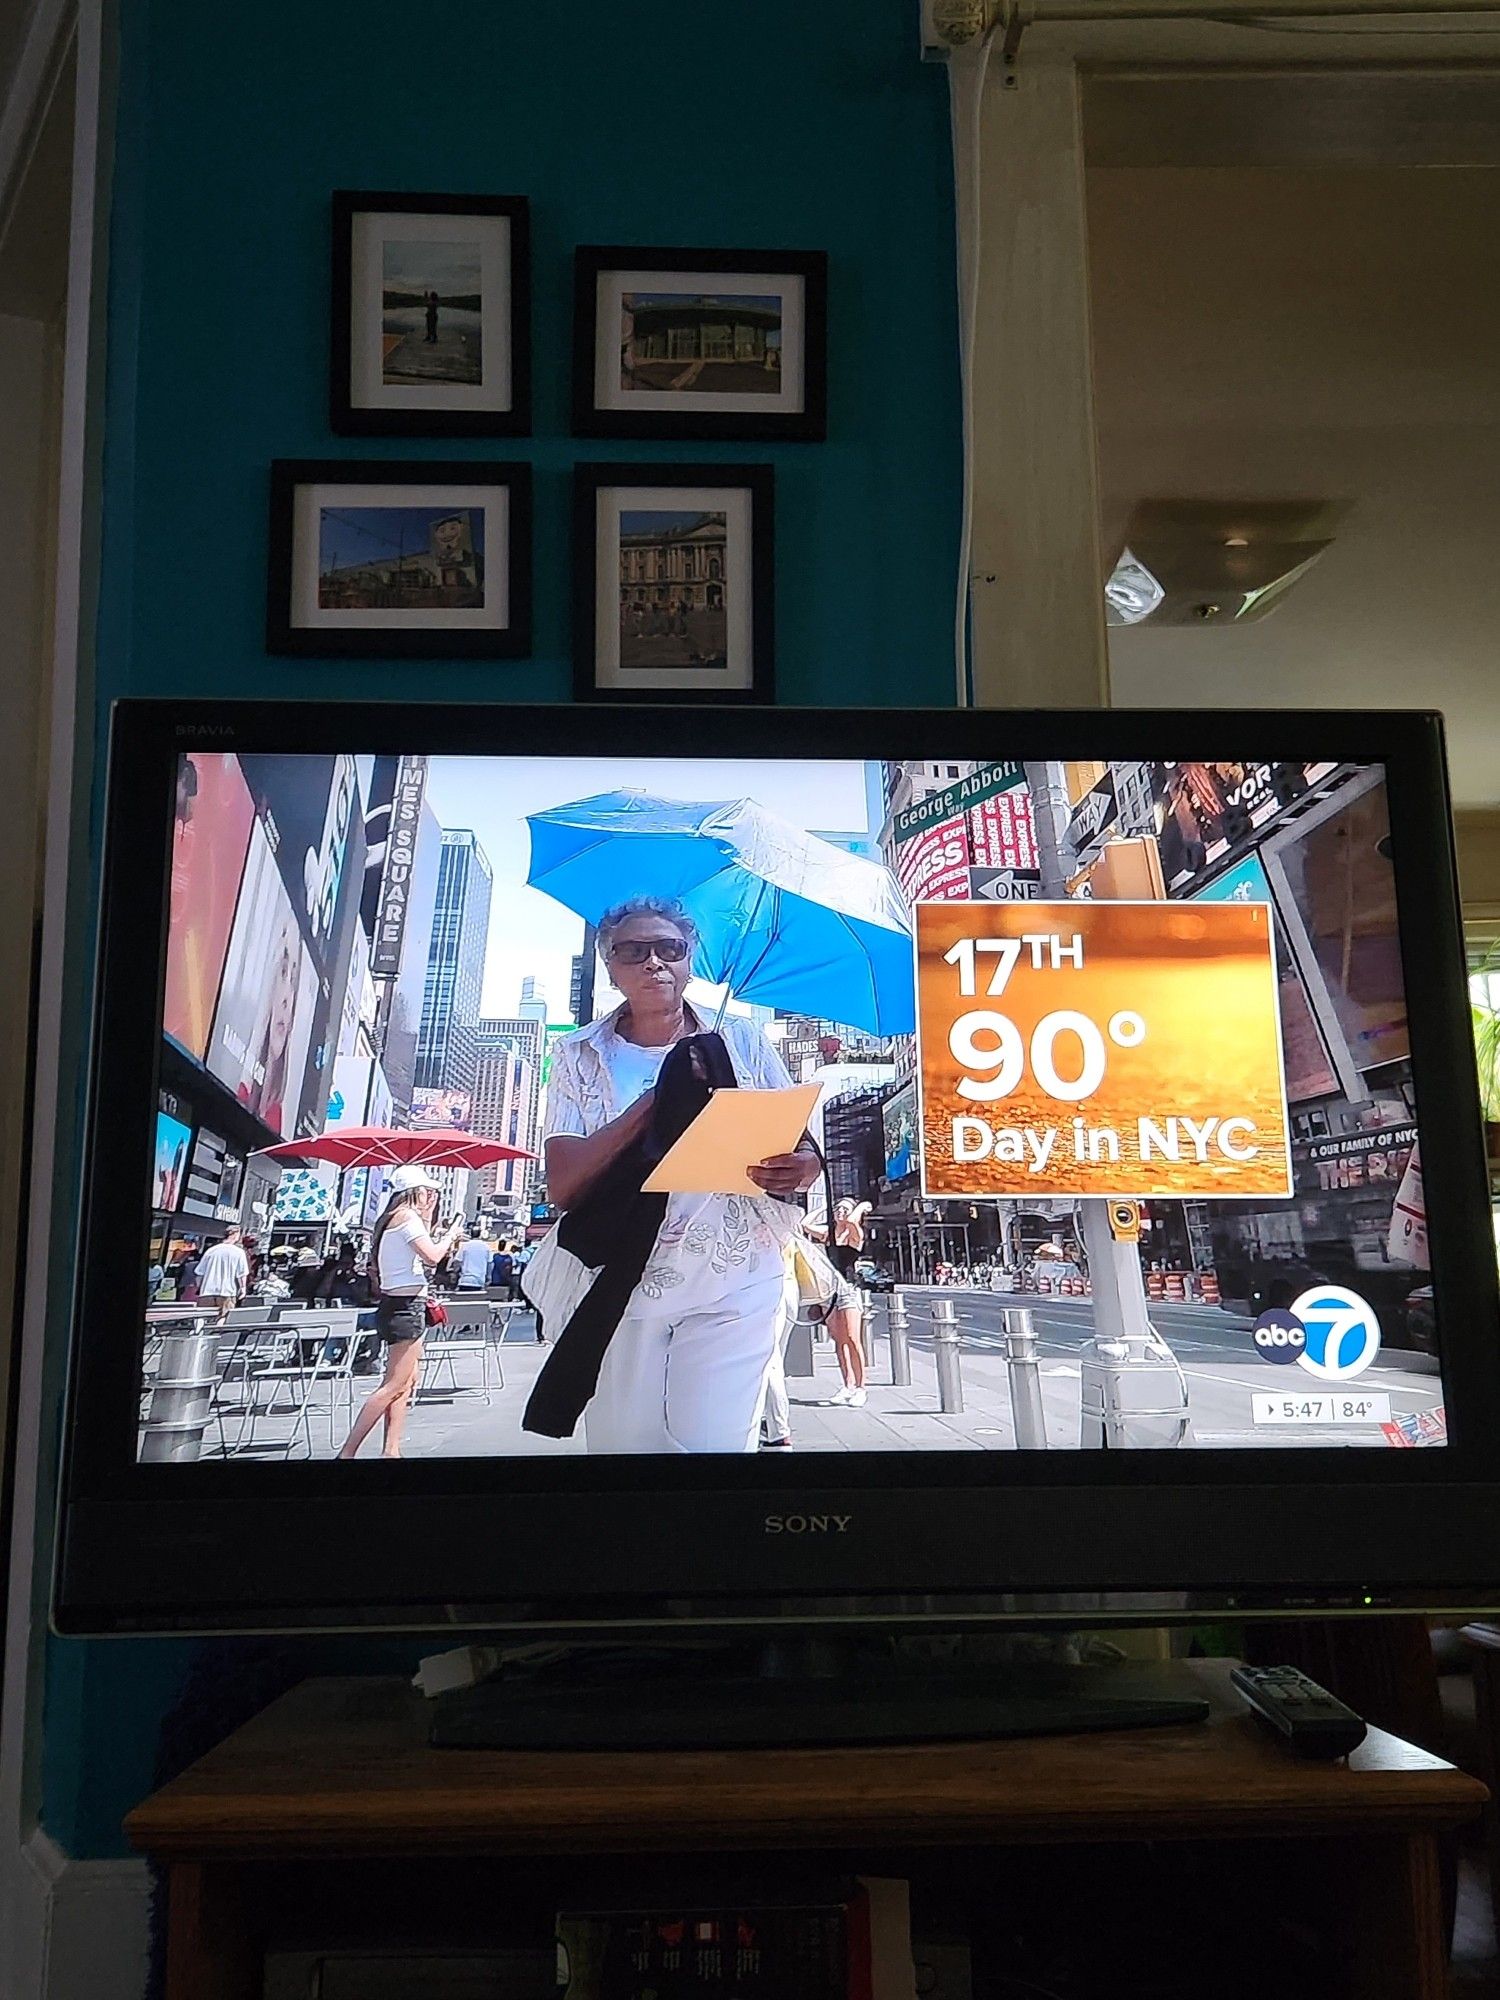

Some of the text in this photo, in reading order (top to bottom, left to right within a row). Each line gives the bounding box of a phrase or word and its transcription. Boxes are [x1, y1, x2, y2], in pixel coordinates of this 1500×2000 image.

[176, 725, 235, 736] BRAVIA
[400, 756, 423, 820] IMES
[900, 791, 953, 830] George
[960, 761, 1018, 800] Abbott
[1077, 797, 1102, 835] WAY
[383, 829, 412, 943] SQUARE
[995, 881, 1038, 900] ONE
[942, 933, 1084, 997] 17TH
[948, 1009, 1147, 1102] 90°
[952, 1116, 1261, 1173] Day in NYC
[1319, 1142, 1340, 1157] OUR
[1341, 1136, 1376, 1153] FAMILY
[1377, 1133, 1392, 1146] OF
[1395, 1128, 1419, 1143] NYC
[1314, 1156, 1363, 1191] THE
[1254, 1323, 1306, 1347] abc
[1283, 1401, 1373, 1418] 5:47 84°
[764, 1515, 852, 1533] SONY
